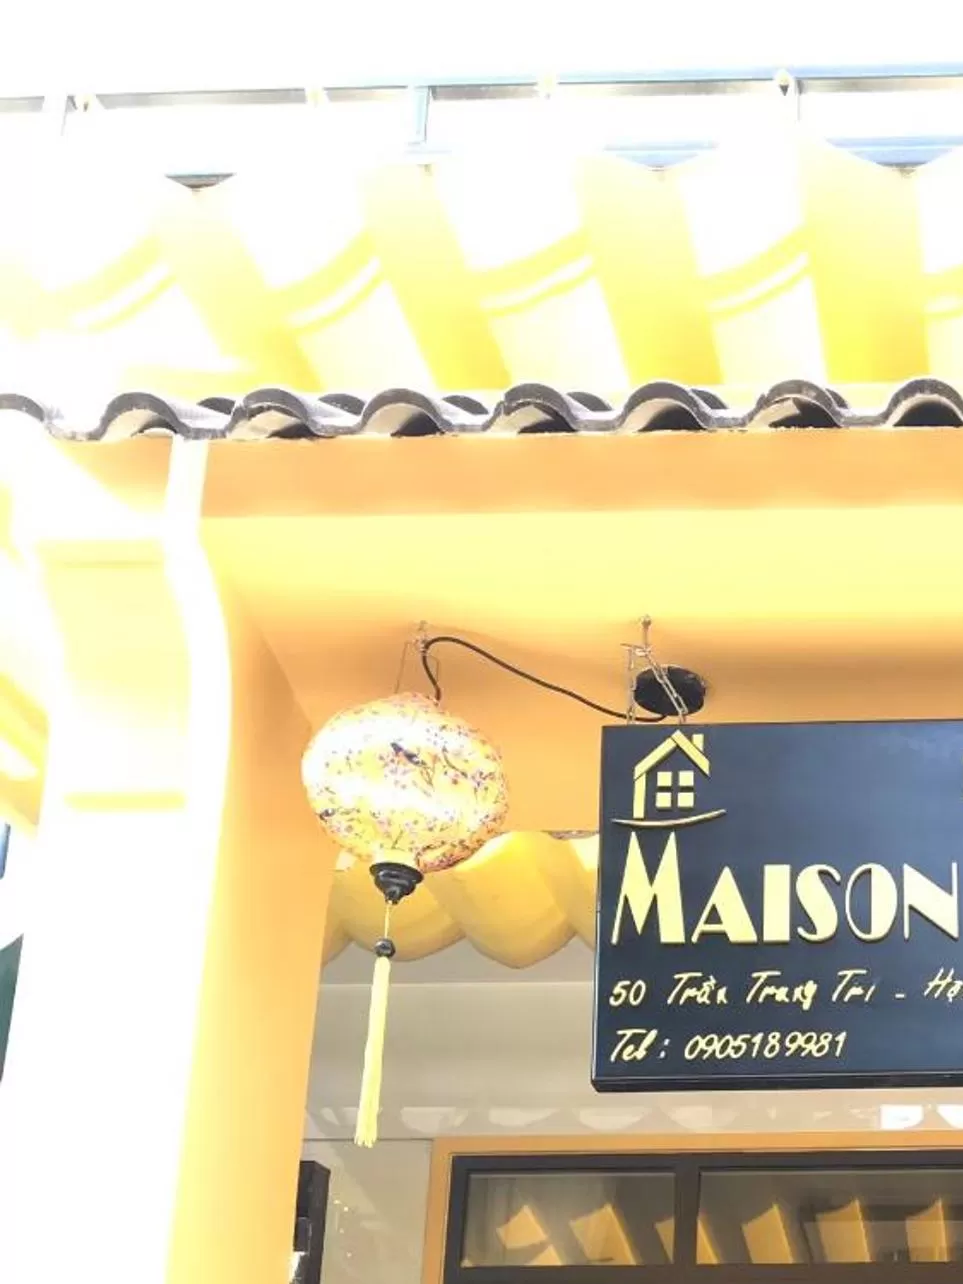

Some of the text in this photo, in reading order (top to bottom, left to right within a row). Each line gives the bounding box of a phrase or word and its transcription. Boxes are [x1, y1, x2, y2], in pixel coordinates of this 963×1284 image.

[611, 832, 960, 945] MAISON
[609, 980, 646, 1006] 50
[667, 971, 728, 1006] Trần
[684, 1030, 848, 1061] 0905189981
